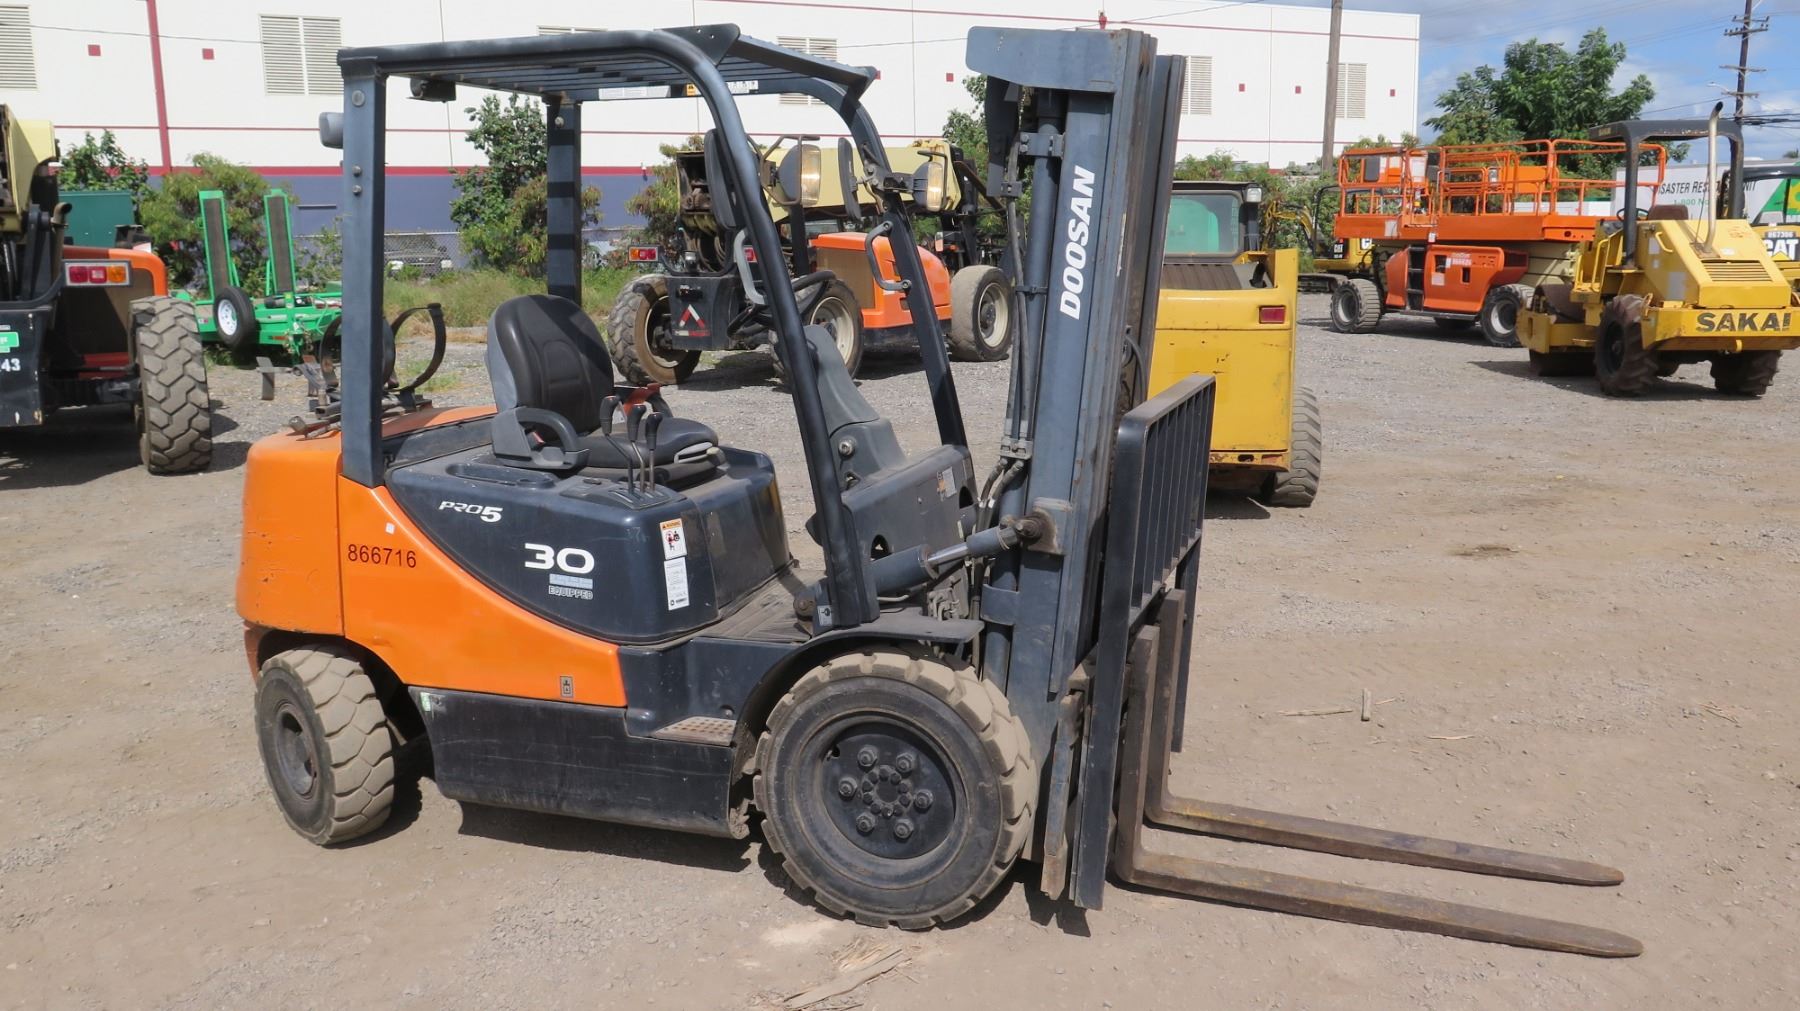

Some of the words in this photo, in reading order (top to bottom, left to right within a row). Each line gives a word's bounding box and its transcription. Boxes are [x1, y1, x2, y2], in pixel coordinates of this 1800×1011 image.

[1060, 165, 1095, 320] DOOSAN
[1696, 312, 1792, 332] SAKAI
[439, 501, 503, 523] PRO5
[348, 544, 417, 568] 866716
[525, 543, 595, 574] 30
[549, 585, 594, 600] EQUIPPED
